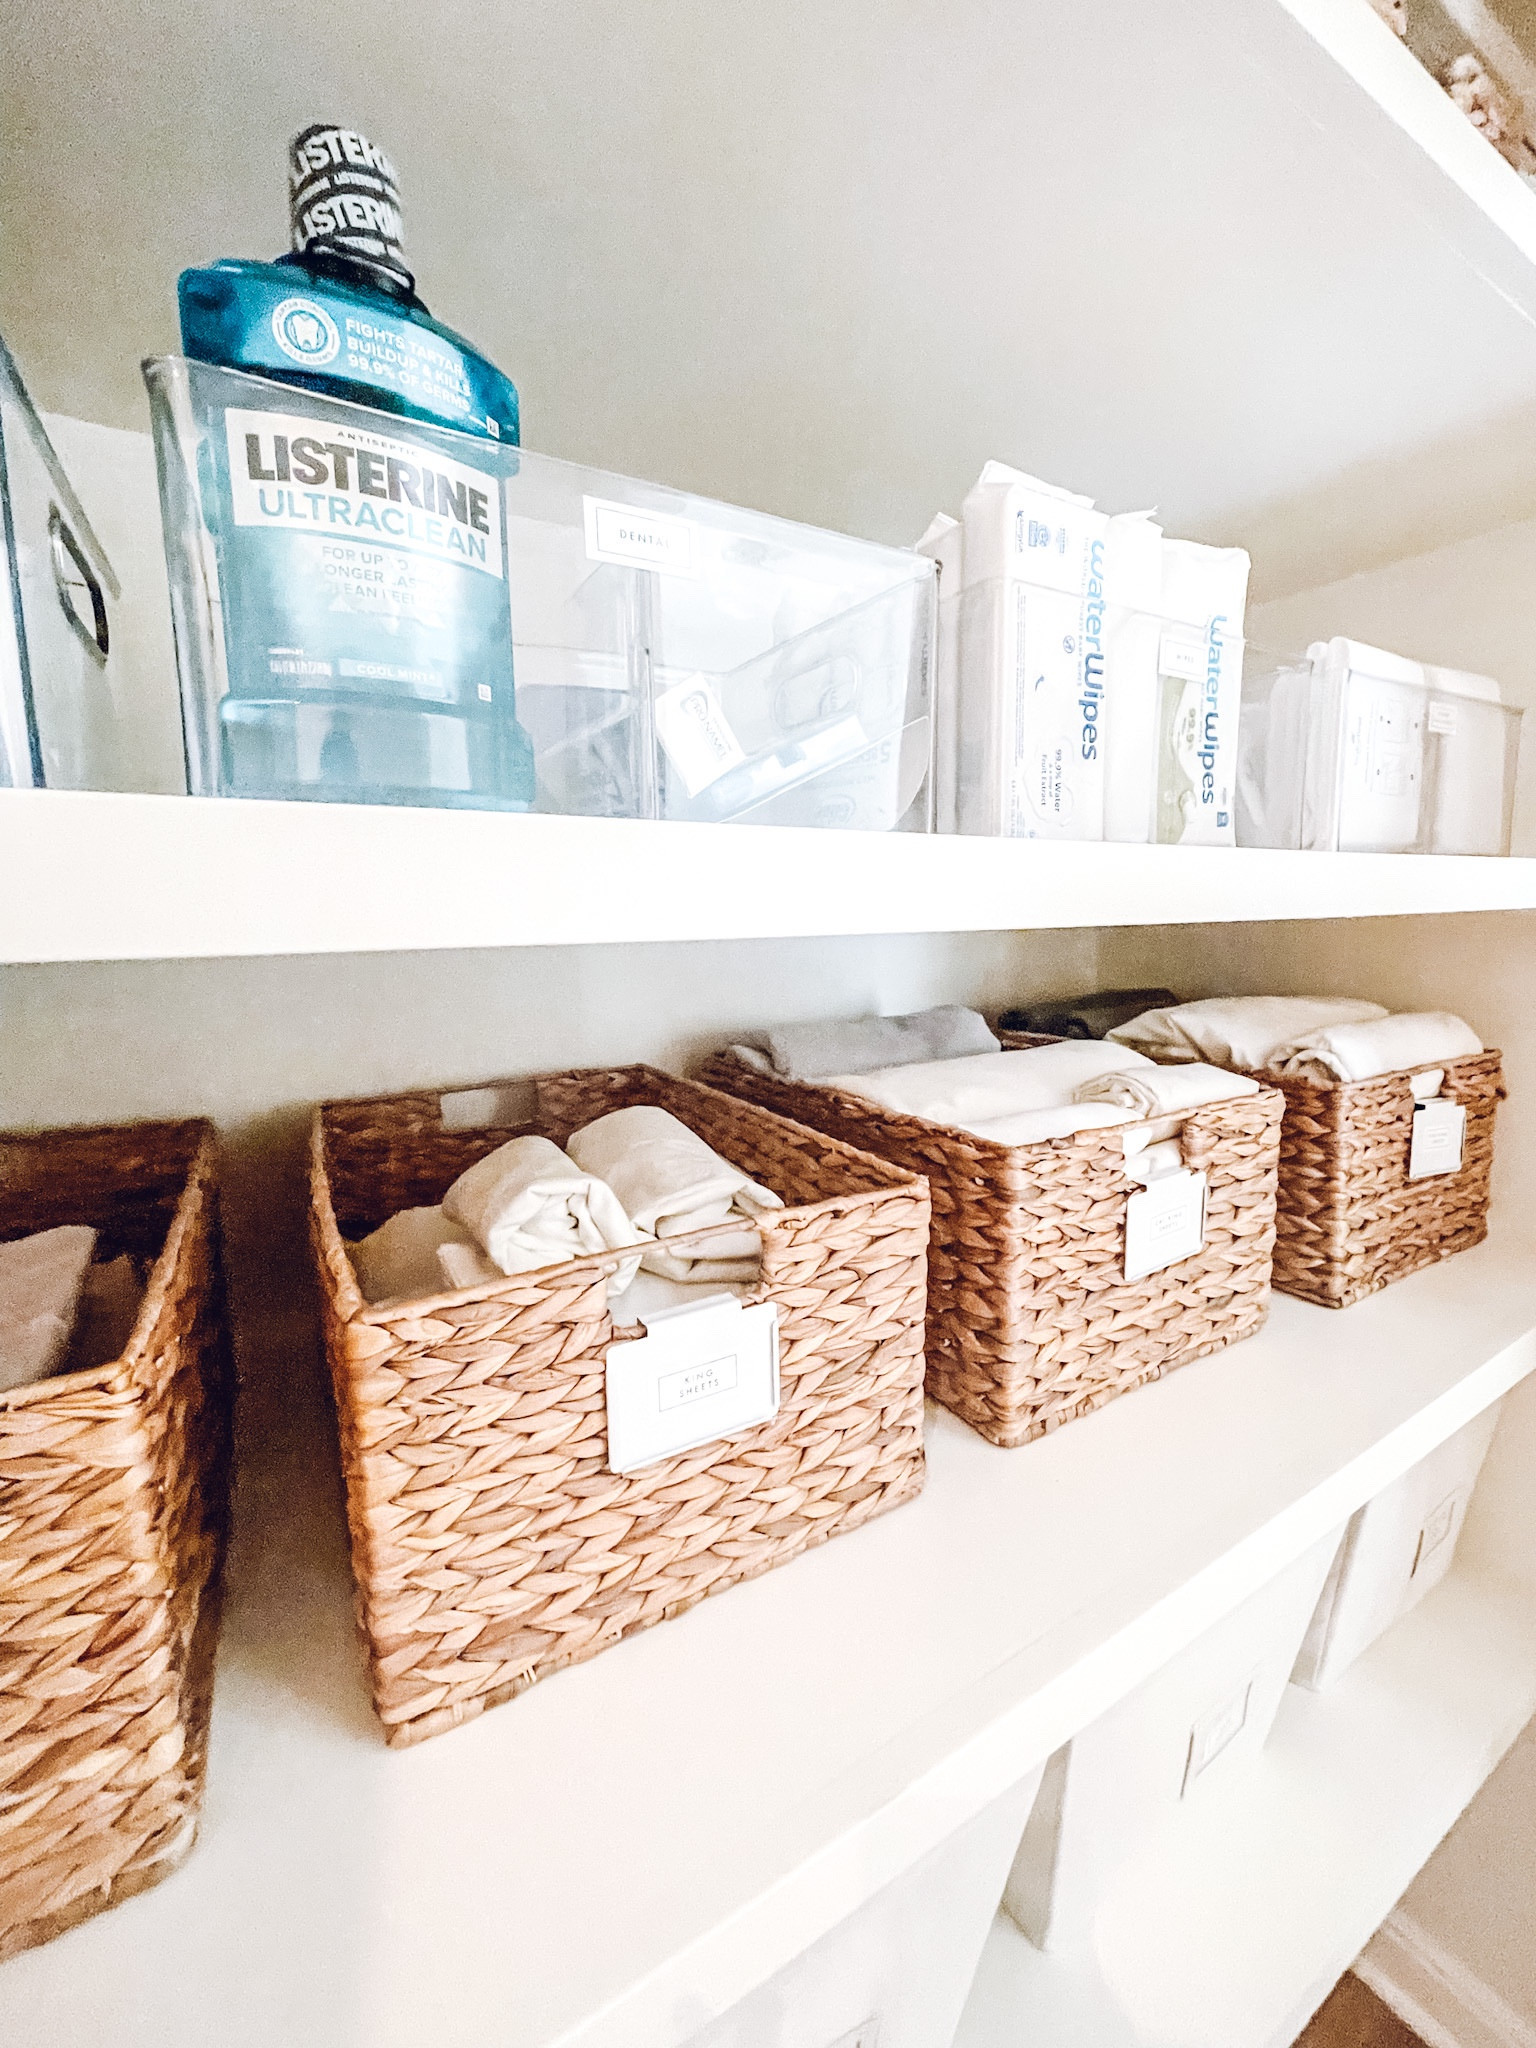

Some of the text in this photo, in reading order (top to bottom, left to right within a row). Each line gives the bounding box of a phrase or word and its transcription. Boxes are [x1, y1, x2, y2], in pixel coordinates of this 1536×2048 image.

[345, 318, 405, 350] FIGHTS
[409, 340, 463, 377] TARTAR
[347, 336, 419, 370] BUILDUP
[435, 367, 471, 397] KILLS
[348, 354, 470, 413] 99.9% OF GERMS
[338, 431, 418, 456] ANTISEPTIC
[245, 433, 490, 535] LISTERINE
[258, 488, 486, 563] ULTRACLEAN
[322, 546, 356, 560] FOR
[361, 552, 383, 565] UP
[318, 563, 384, 583] ONGER
[357, 663, 395, 678] COOL
[1054, 782, 1062, 813] Water
[679, 1378, 719, 1398] SHEETS
[684, 1369, 713, 1384] KING
